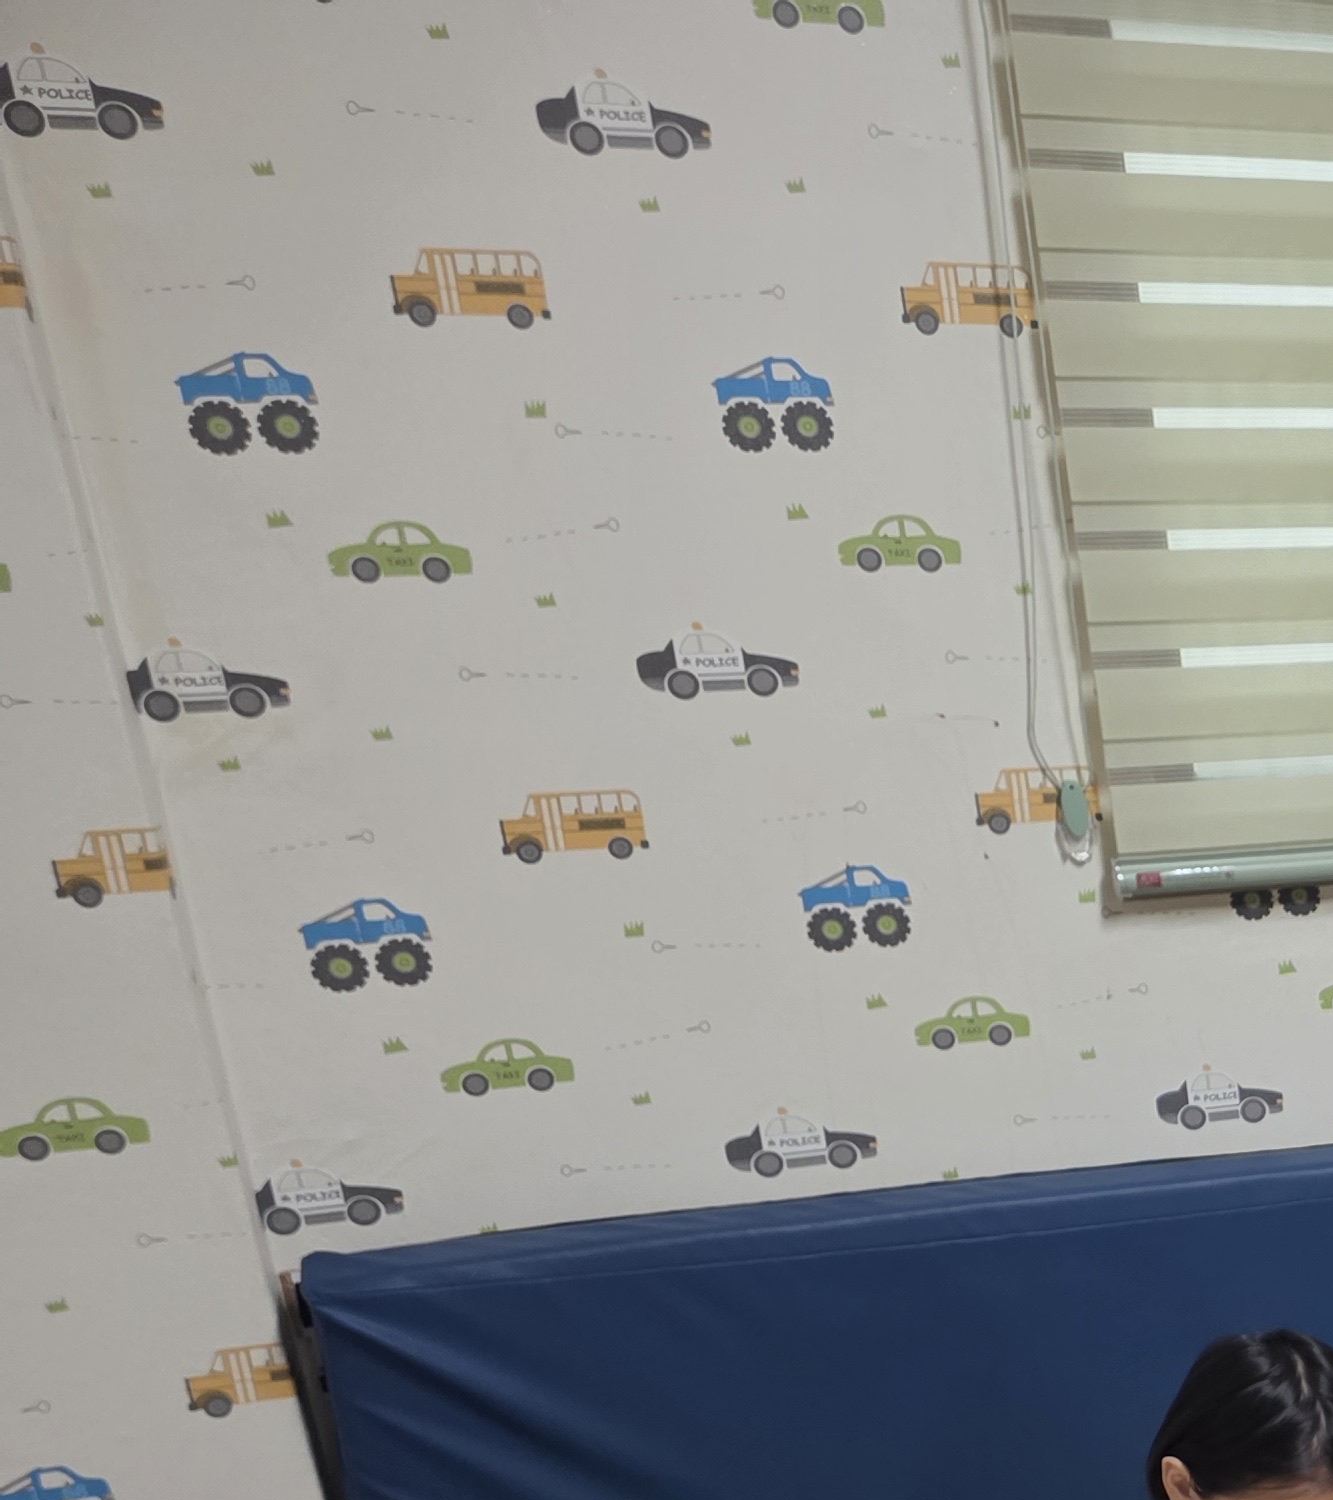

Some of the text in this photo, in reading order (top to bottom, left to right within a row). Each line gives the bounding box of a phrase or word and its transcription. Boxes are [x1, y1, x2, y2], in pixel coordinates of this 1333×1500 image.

[38, 87, 93, 100] POLICE
[599, 109, 646, 123] POLICE
[696, 656, 739, 668] POLICE
[174, 676, 223, 688] POLICE
[1204, 1091, 1237, 1102] POLICE
[780, 1135, 821, 1147] POLICE
